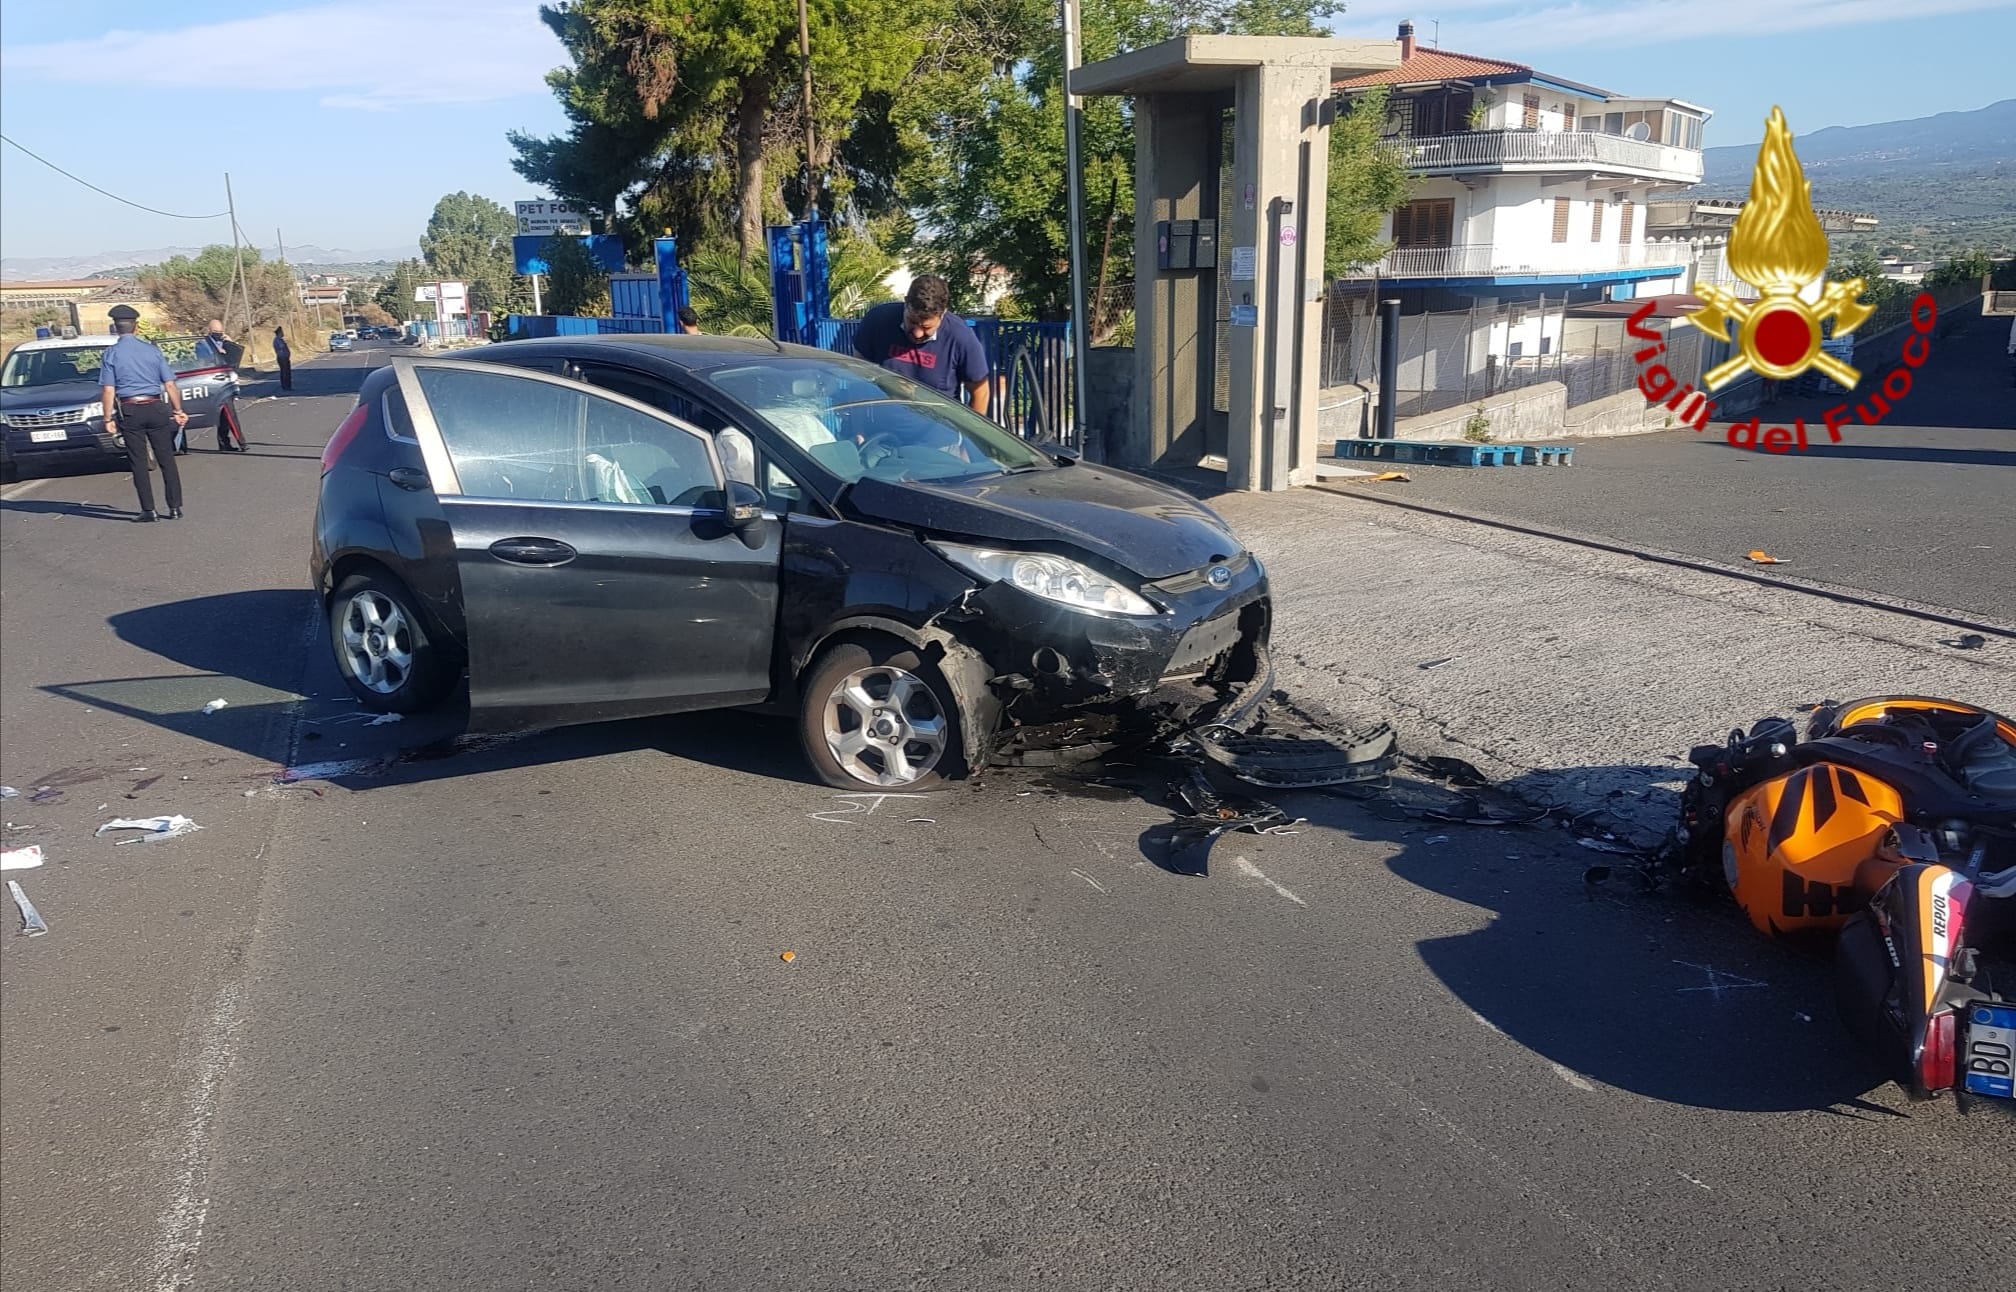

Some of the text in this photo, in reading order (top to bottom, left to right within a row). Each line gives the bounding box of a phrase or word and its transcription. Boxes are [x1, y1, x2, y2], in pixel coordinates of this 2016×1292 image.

[518, 203, 578, 214] PET FOO
[1934, 894, 1946, 938] REPSOL
[1969, 1040, 2012, 1076] BD
